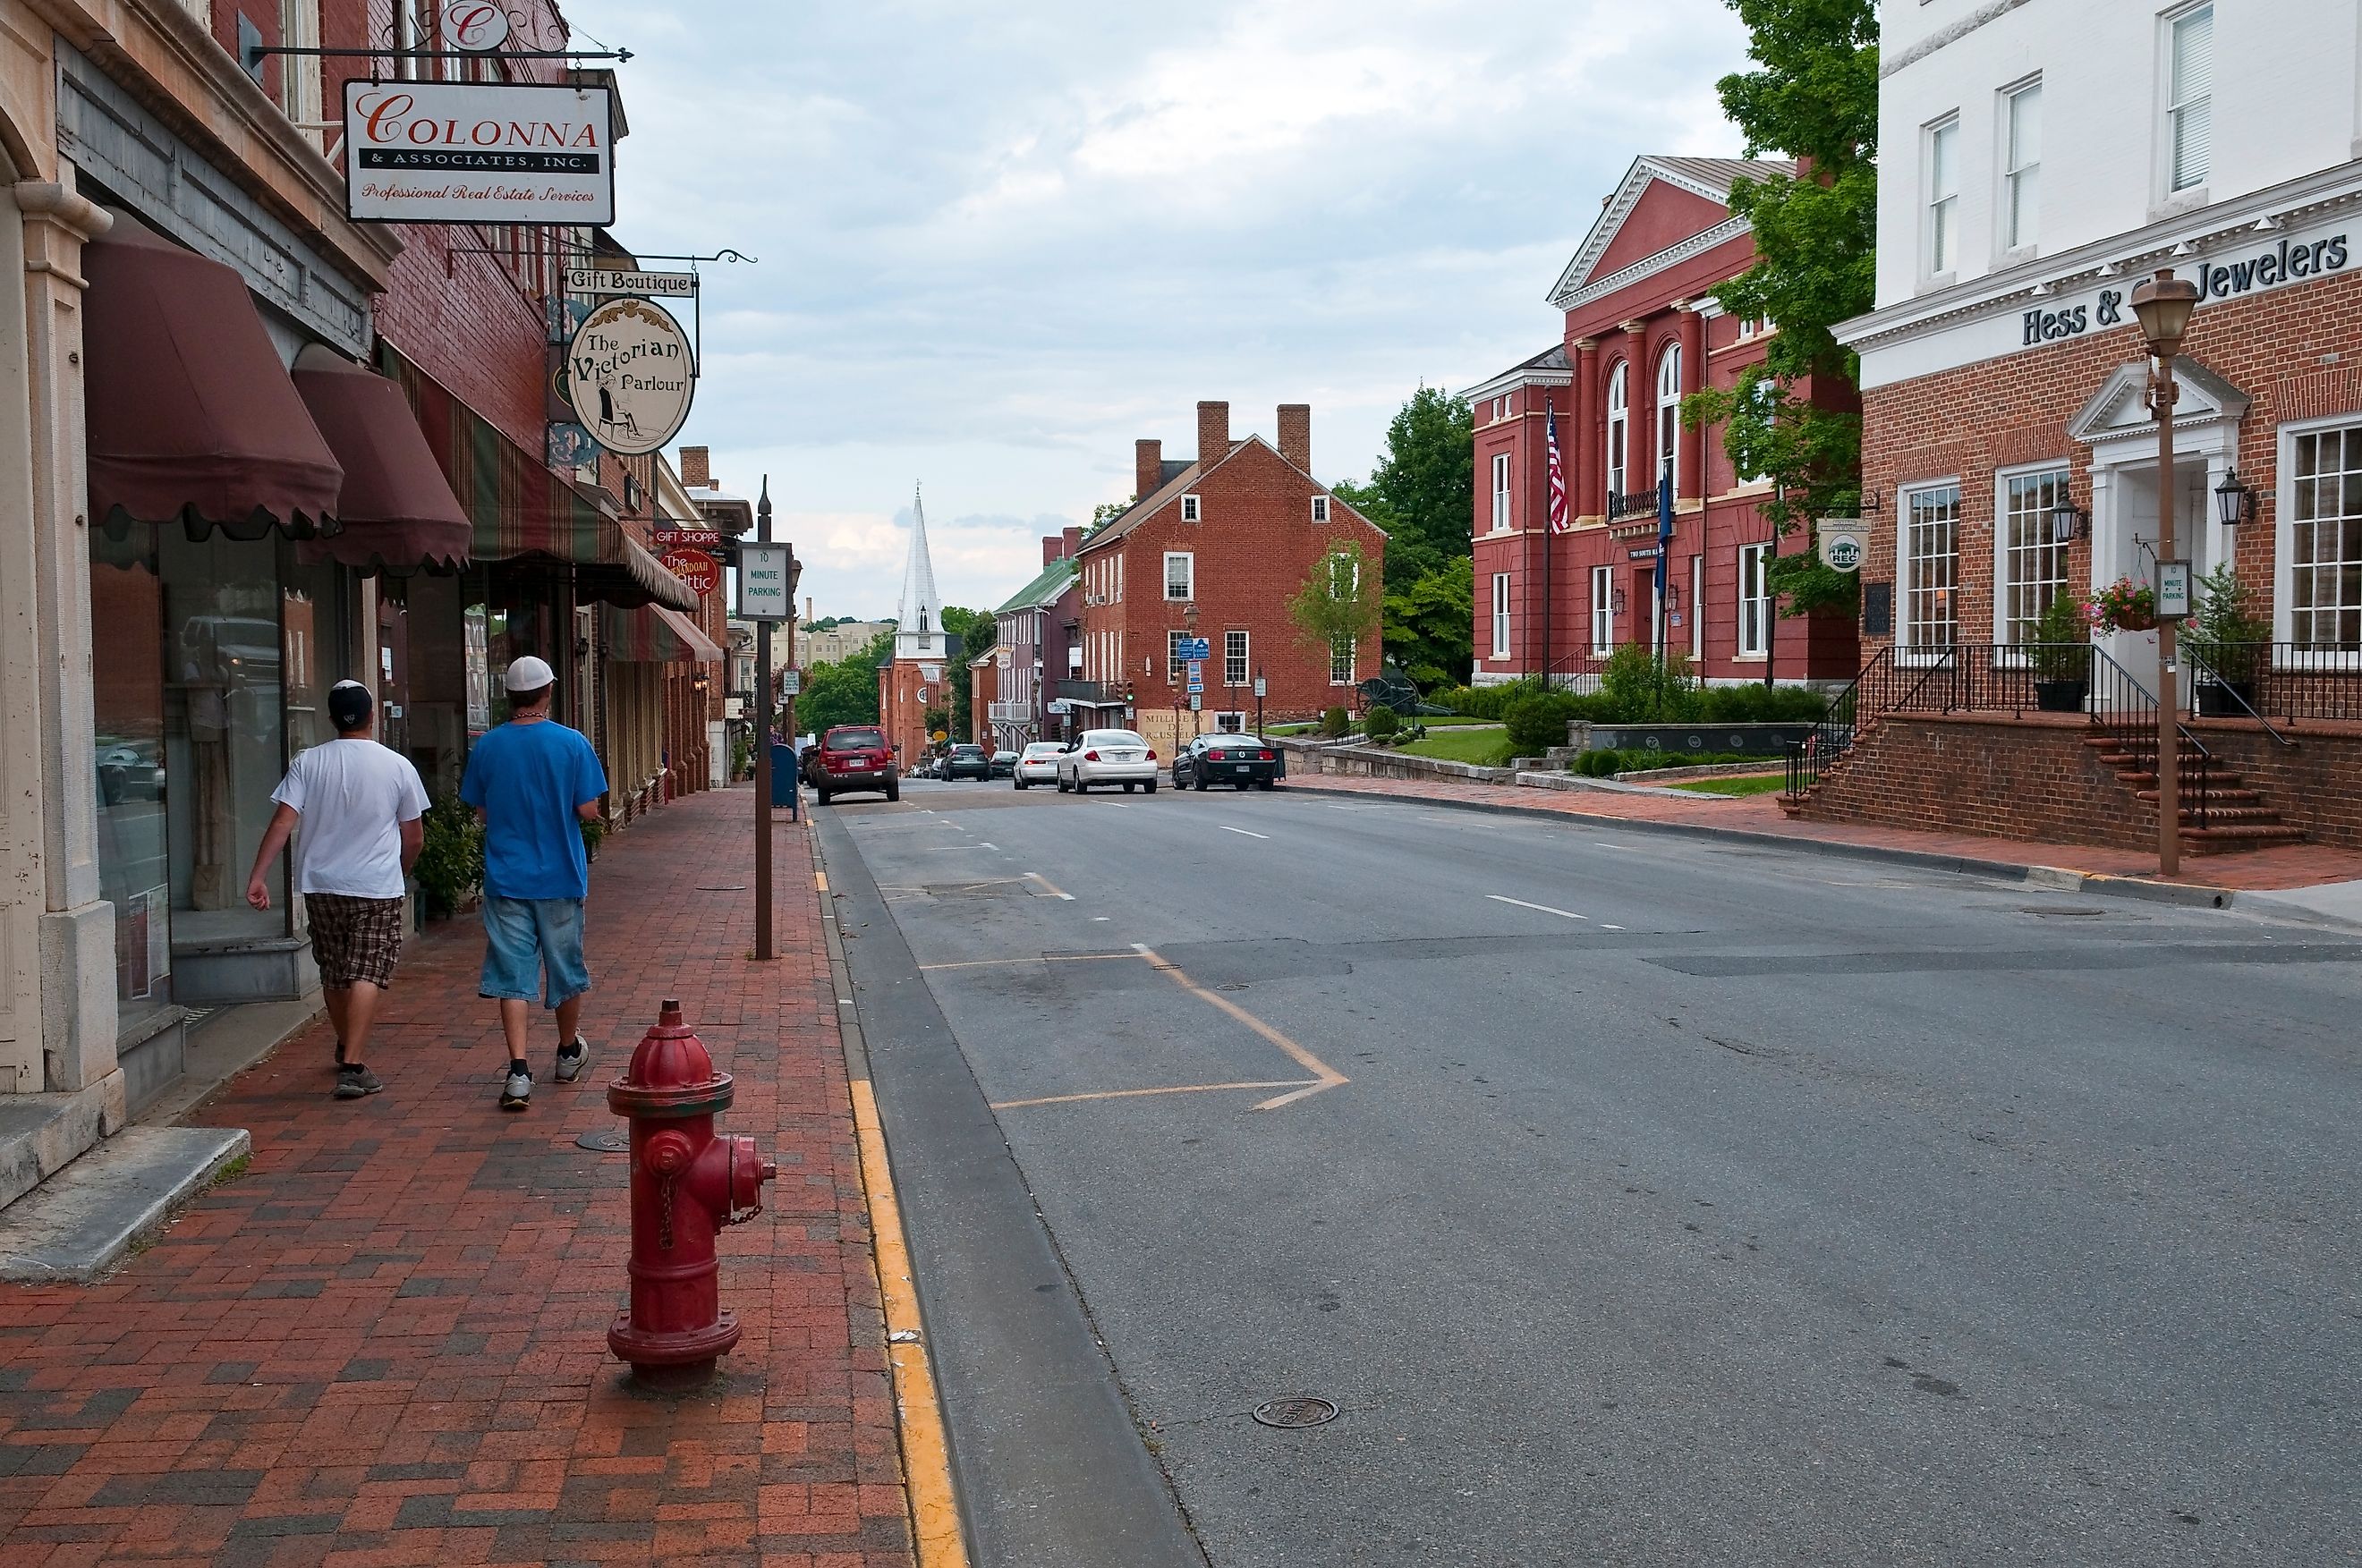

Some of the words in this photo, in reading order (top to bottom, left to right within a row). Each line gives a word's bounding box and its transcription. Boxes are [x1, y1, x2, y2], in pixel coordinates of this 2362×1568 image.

[450, 5, 495, 45] C
[355, 92, 599, 148] COLONNA
[371, 154, 384, 164] &
[394, 154, 534, 168] ASSOCIATES,
[543, 157, 587, 168] INC.
[361, 183, 449, 201] Professional
[452, 184, 490, 199] Real
[493, 186, 535, 200] Estate
[539, 186, 594, 202] Services
[571, 271, 606, 290] Gift
[610, 272, 688, 292] Boutique
[2023, 305, 2086, 345] Hess
[2096, 290, 2121, 326] &
[2196, 234, 2348, 302] Jewelers
[588, 335, 619, 352] The
[572, 338, 679, 381] Victorian
[621, 374, 684, 391] Parlour
[657, 531, 679, 542] GIFT
[682, 532, 719, 542] SHOPPE
[665, 555, 688, 567] The
[760, 552, 769, 563] 10
[1832, 555, 1857, 563] REC
[751, 570, 778, 580] MINUTE
[2171, 566, 2177, 574] 10
[2164, 579, 2182, 587] MINUTE
[748, 587, 781, 597] PARKING
